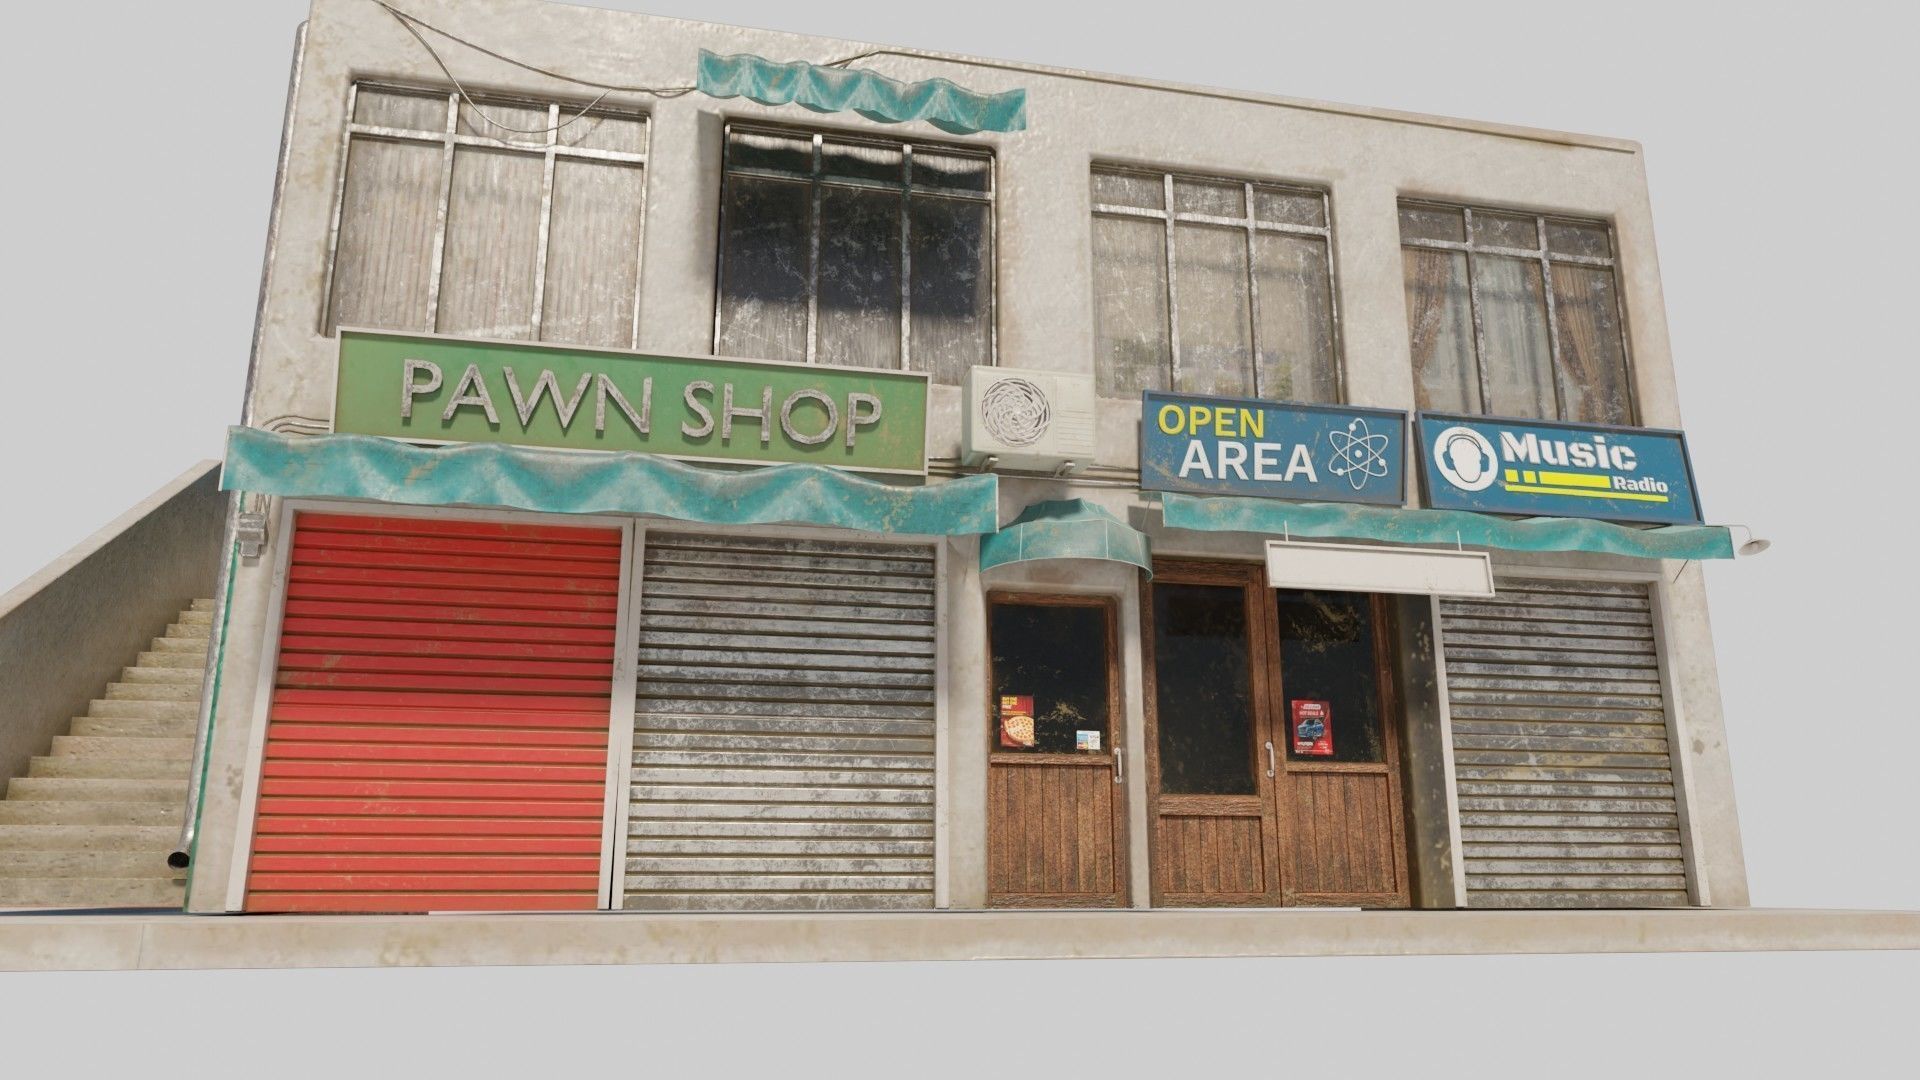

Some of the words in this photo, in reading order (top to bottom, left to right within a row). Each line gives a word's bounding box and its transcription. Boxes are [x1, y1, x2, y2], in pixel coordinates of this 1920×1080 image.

[401, 359, 653, 435] PAWN
[681, 380, 883, 448] SHOP
[1158, 404, 1265, 439] OPEN
[1178, 439, 1319, 483] AREA
[1501, 431, 1638, 472] Music
[1613, 475, 1669, 494] Radio
